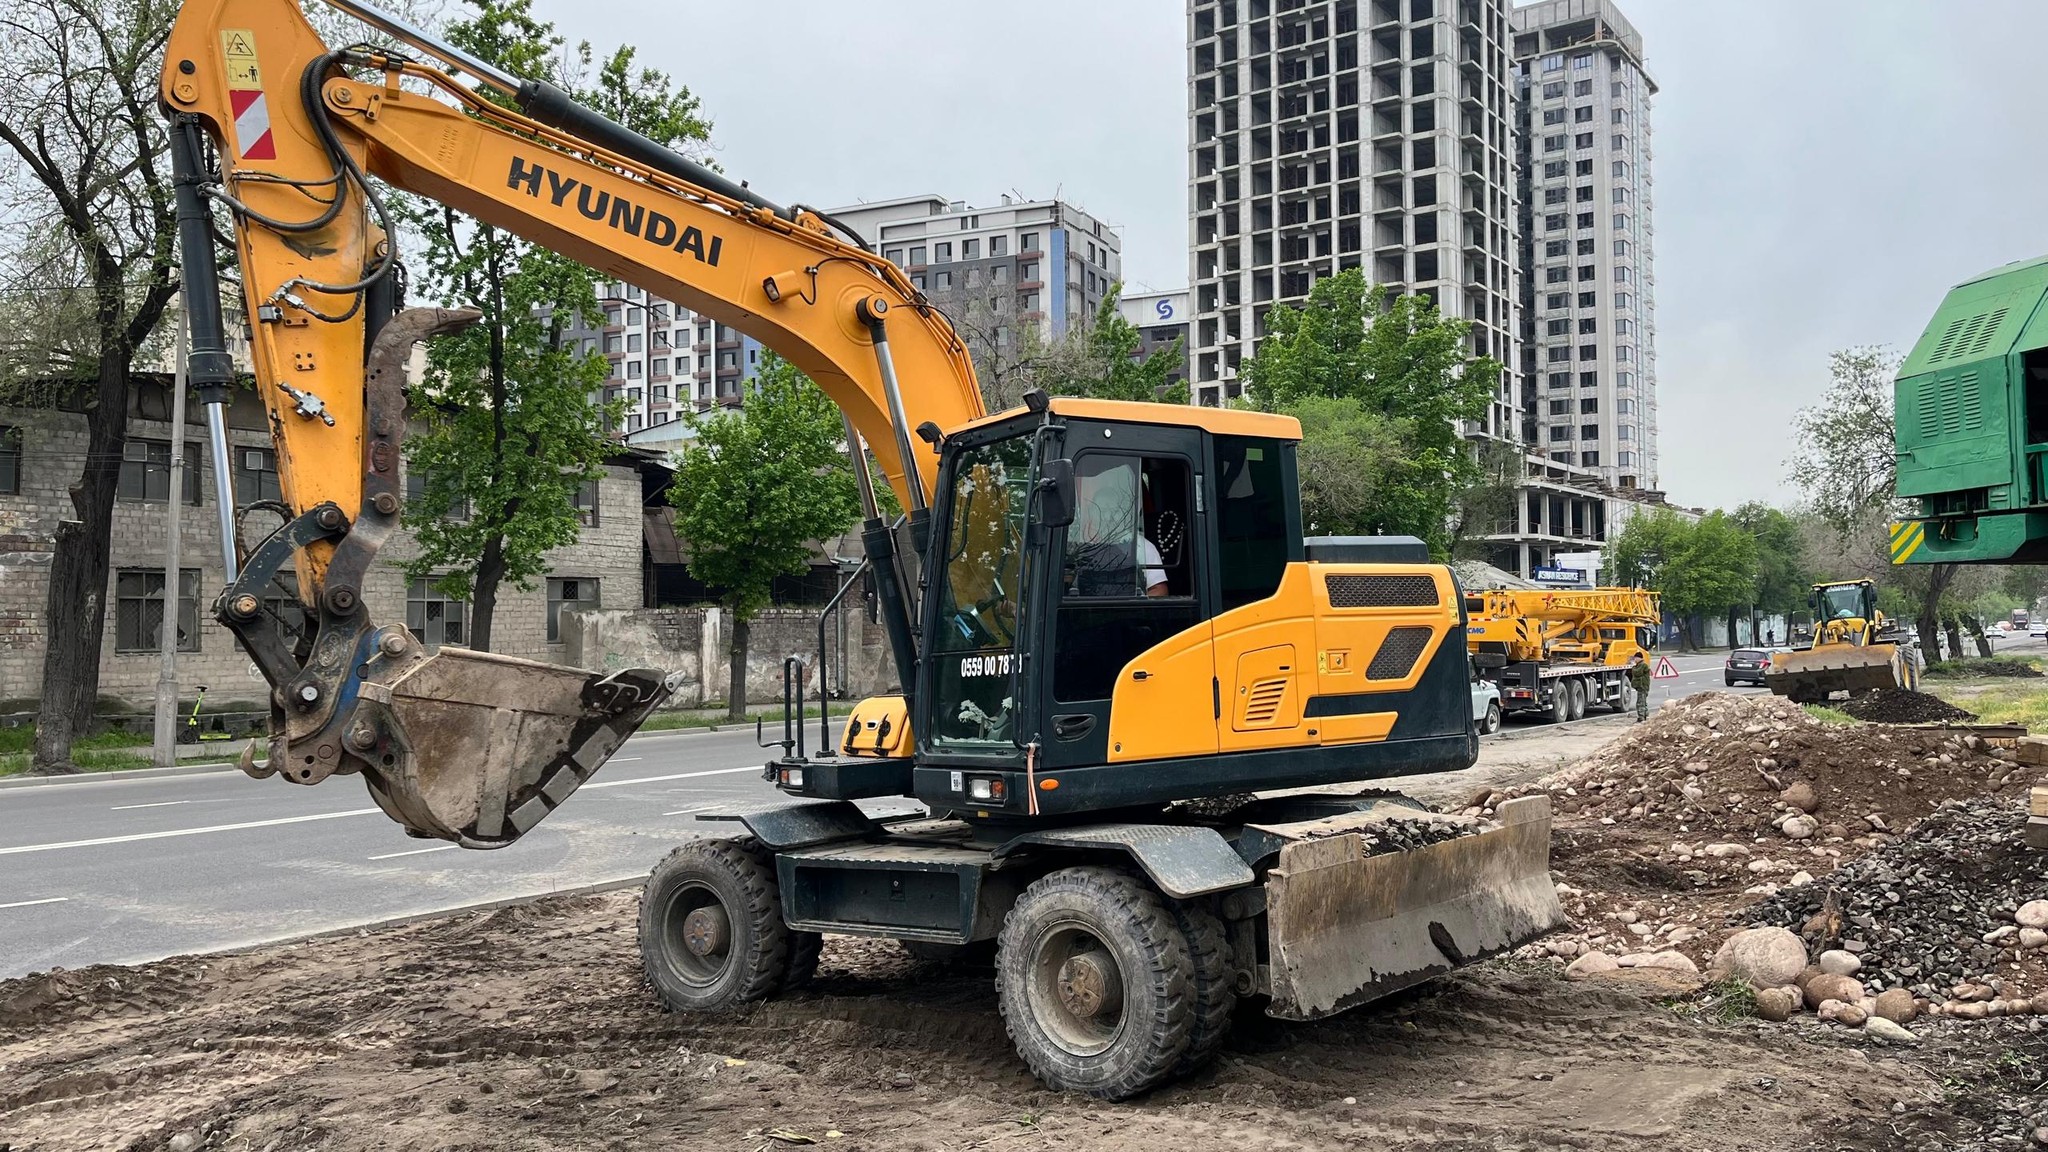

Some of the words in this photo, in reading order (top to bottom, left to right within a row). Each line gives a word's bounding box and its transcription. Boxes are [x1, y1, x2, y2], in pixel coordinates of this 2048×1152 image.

[507, 156, 723, 267] HYUNDAI
[961, 657, 983, 678] 0559
[984, 656, 996, 676] 00
[998, 654, 1010, 674] 78
